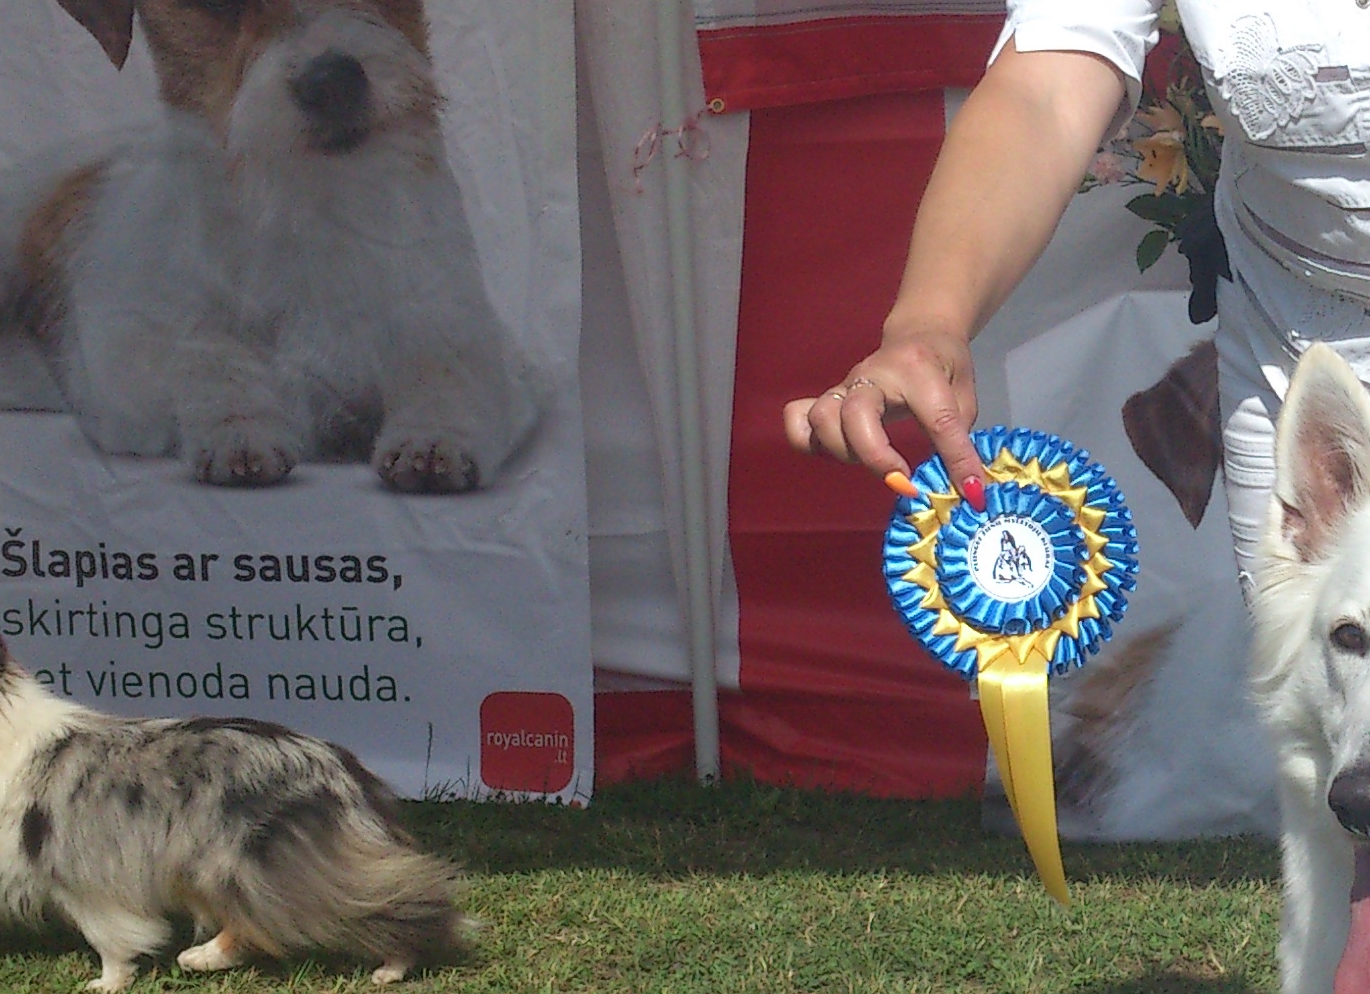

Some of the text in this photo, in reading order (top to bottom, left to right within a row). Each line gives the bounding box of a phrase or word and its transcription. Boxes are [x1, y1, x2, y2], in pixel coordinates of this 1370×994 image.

[1, 527, 402, 591] Šlapias ar sausas,
[3, 599, 422, 649] skirtinga struktūra,
[86, 660, 250, 700] vienoda
[268, 665, 410, 701] nauda.
[487, 729, 569, 750] royalcanin
